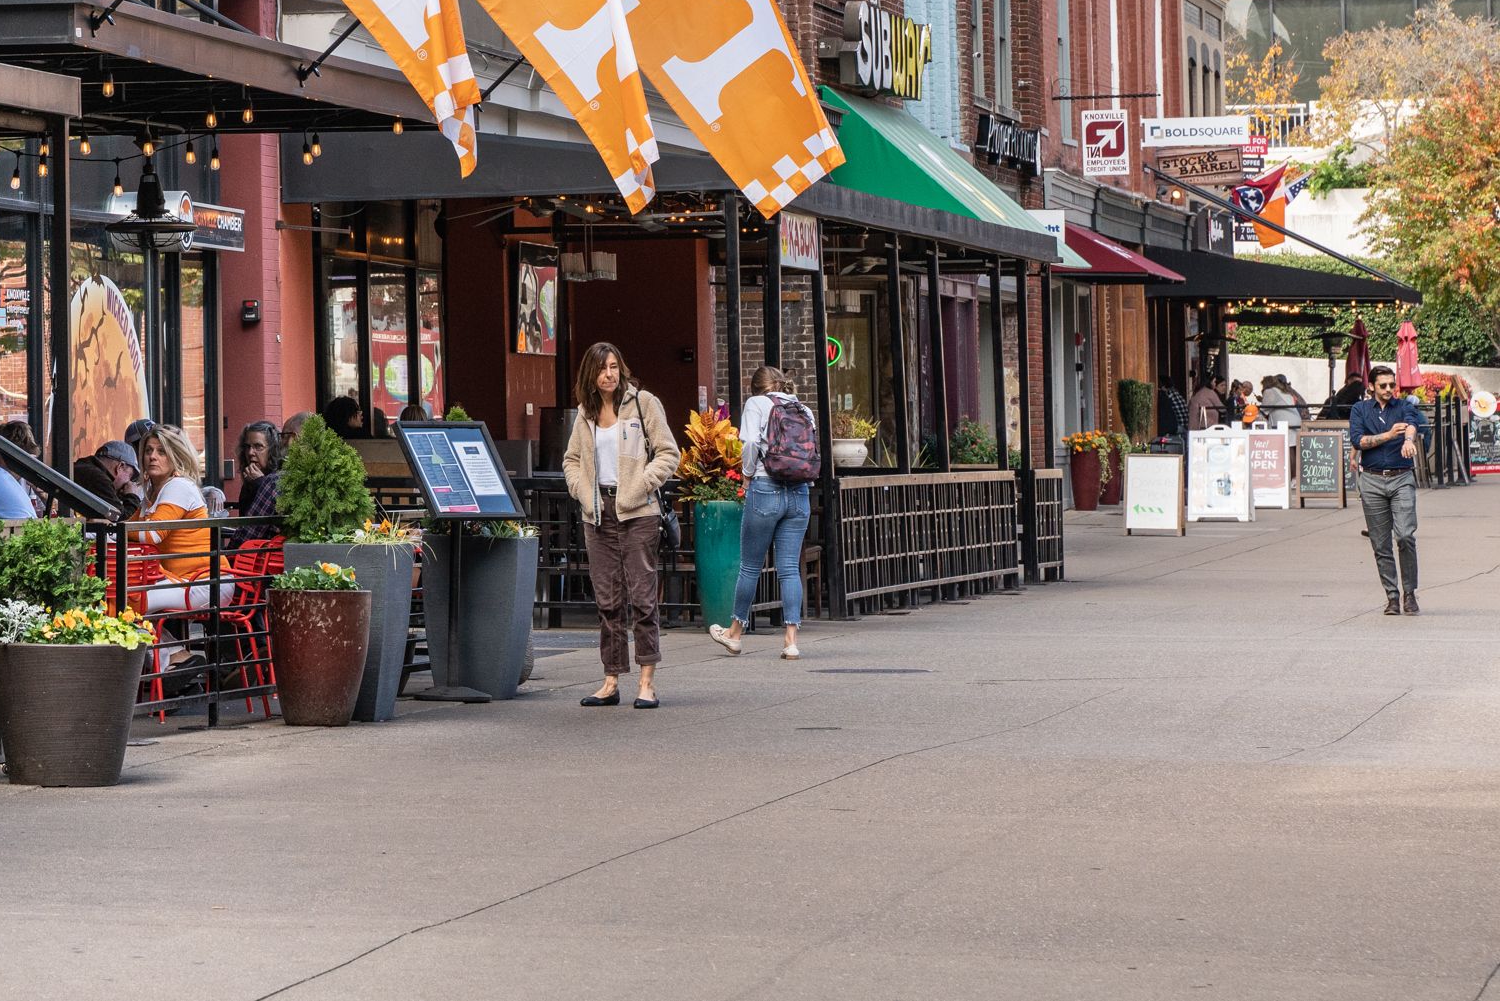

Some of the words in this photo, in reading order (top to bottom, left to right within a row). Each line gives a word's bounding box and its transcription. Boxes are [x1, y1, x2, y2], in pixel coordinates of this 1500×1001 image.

[857, 1, 932, 101] SUBWAY
[1086, 146, 1101, 159] TVA
[1163, 155, 1206, 169] STOCK
[1179, 160, 1237, 175] BARREL
[217, 215, 242, 232] CHAMBER
[788, 218, 817, 262] KABUKI
[106, 285, 129, 337] WICKED
